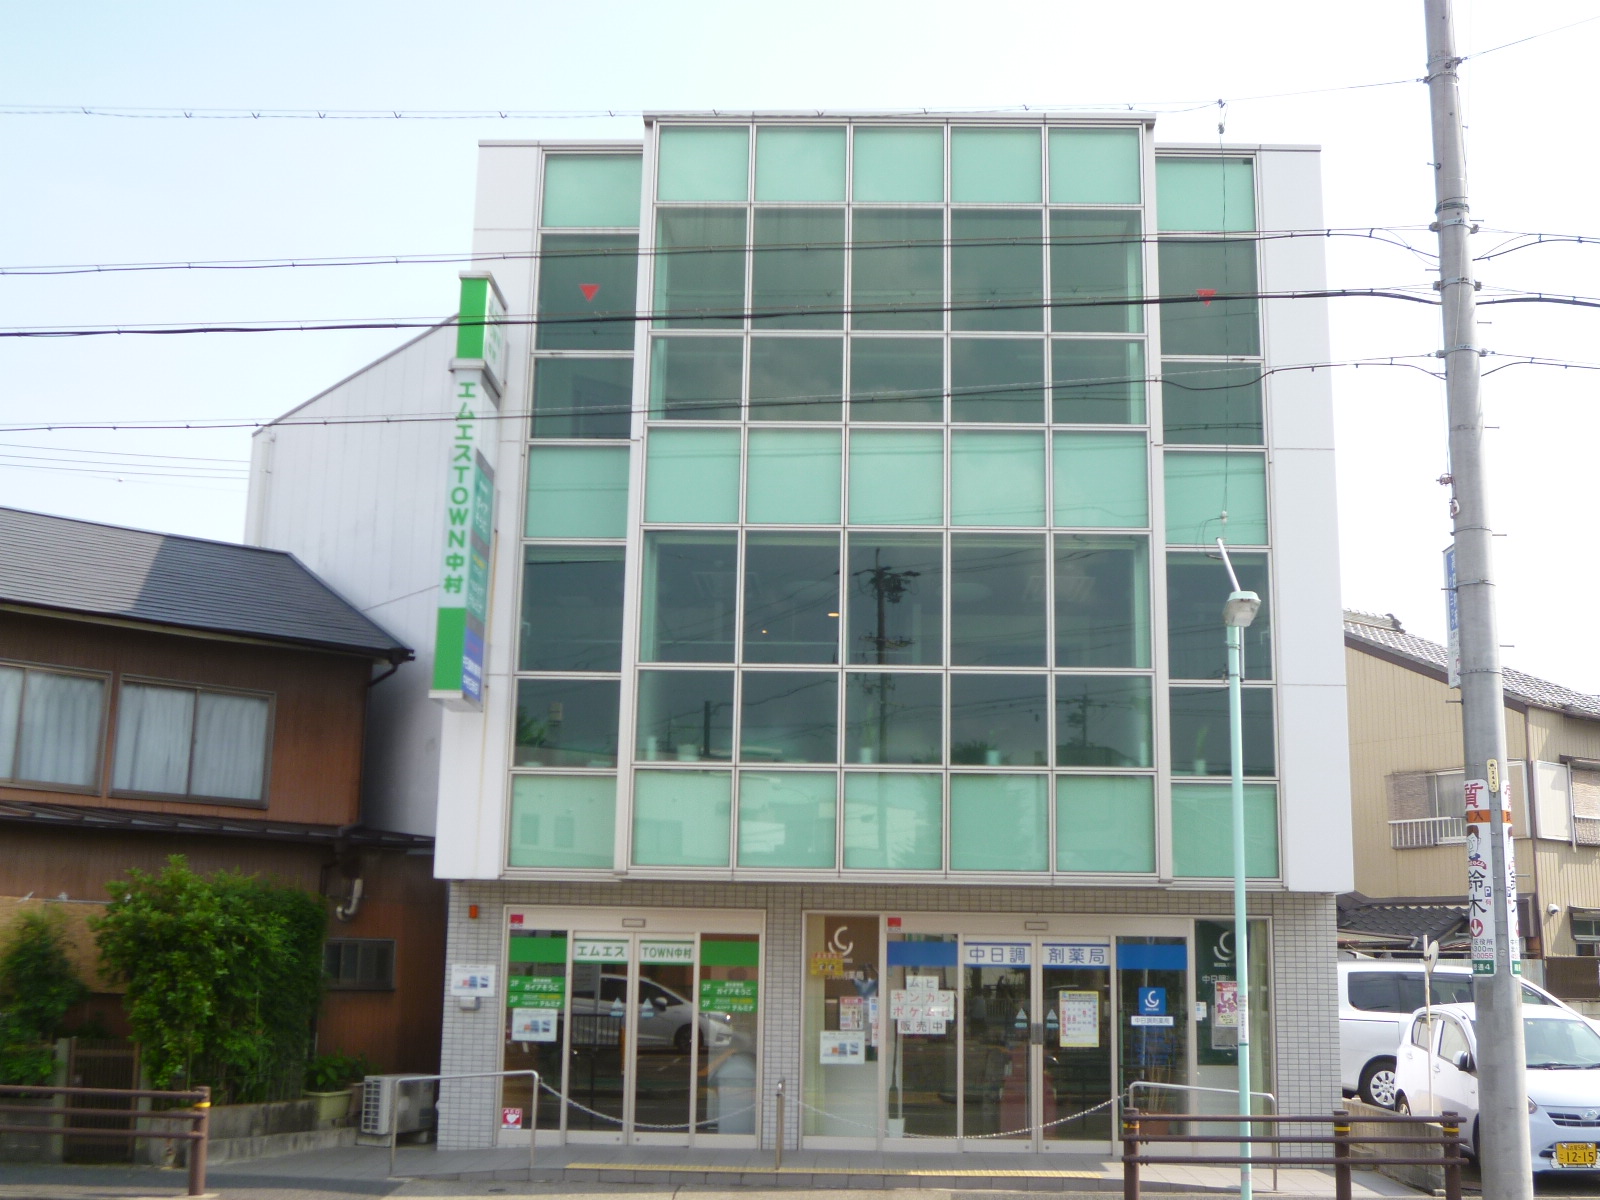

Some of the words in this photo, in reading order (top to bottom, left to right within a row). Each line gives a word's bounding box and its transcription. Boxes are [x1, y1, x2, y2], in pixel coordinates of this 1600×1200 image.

[443, 382, 476, 594] エムエスTOWN中村
[1468, 869, 1487, 917] 鈴木
[577, 945, 625, 958] エムエス
[642, 947, 692, 959] TOWN中村
[969, 946, 1026, 963] 中日調
[1048, 947, 1105, 964] 剤薬局
[909, 979, 935, 988] ムヒ
[894, 992, 951, 1002] キンカン
[900, 1020, 943, 1032] 販売中
[1567, 1151, 1594, 1162] 12-15
